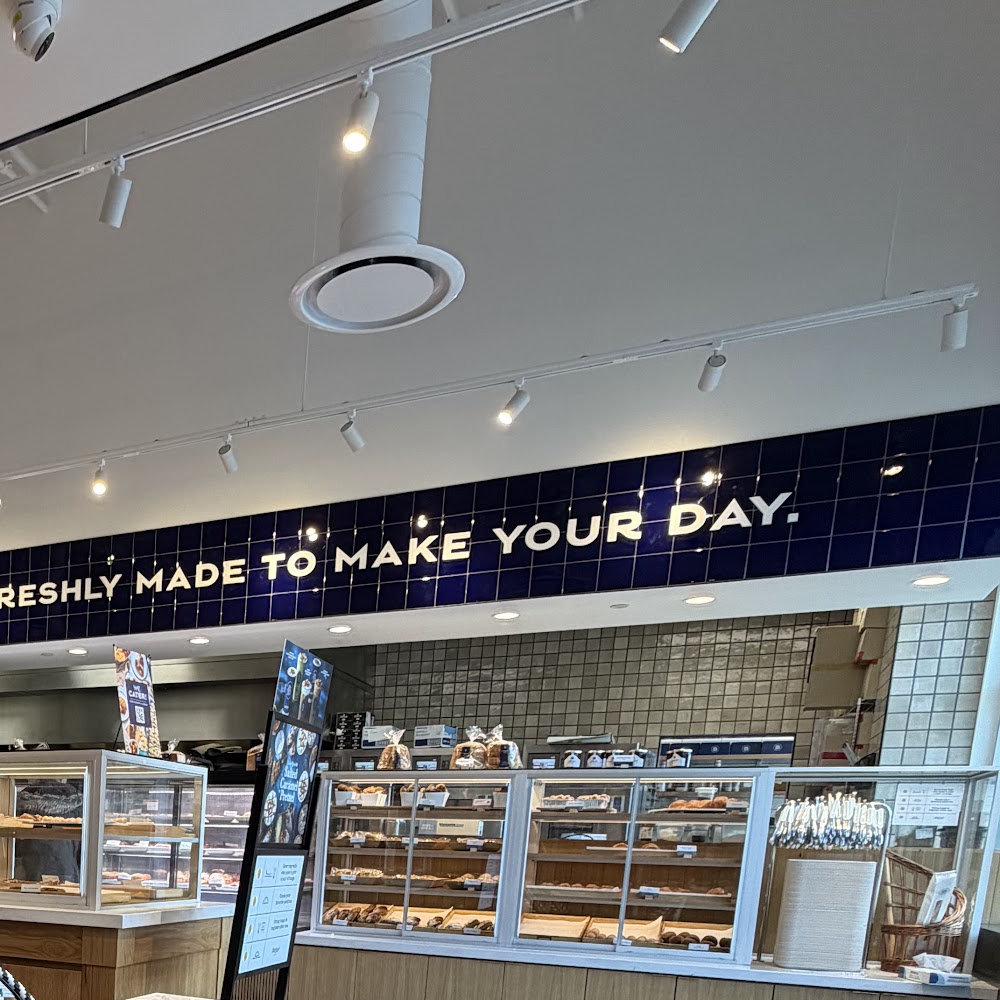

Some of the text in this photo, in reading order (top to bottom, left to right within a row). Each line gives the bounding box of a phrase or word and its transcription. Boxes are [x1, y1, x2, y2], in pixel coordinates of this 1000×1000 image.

[136, 558, 247, 596] MADE
[261, 550, 317, 581] TO
[334, 529, 471, 574] MAKE
[493, 511, 643, 556] YOUR
[667, 491, 800, 537] DAY.
